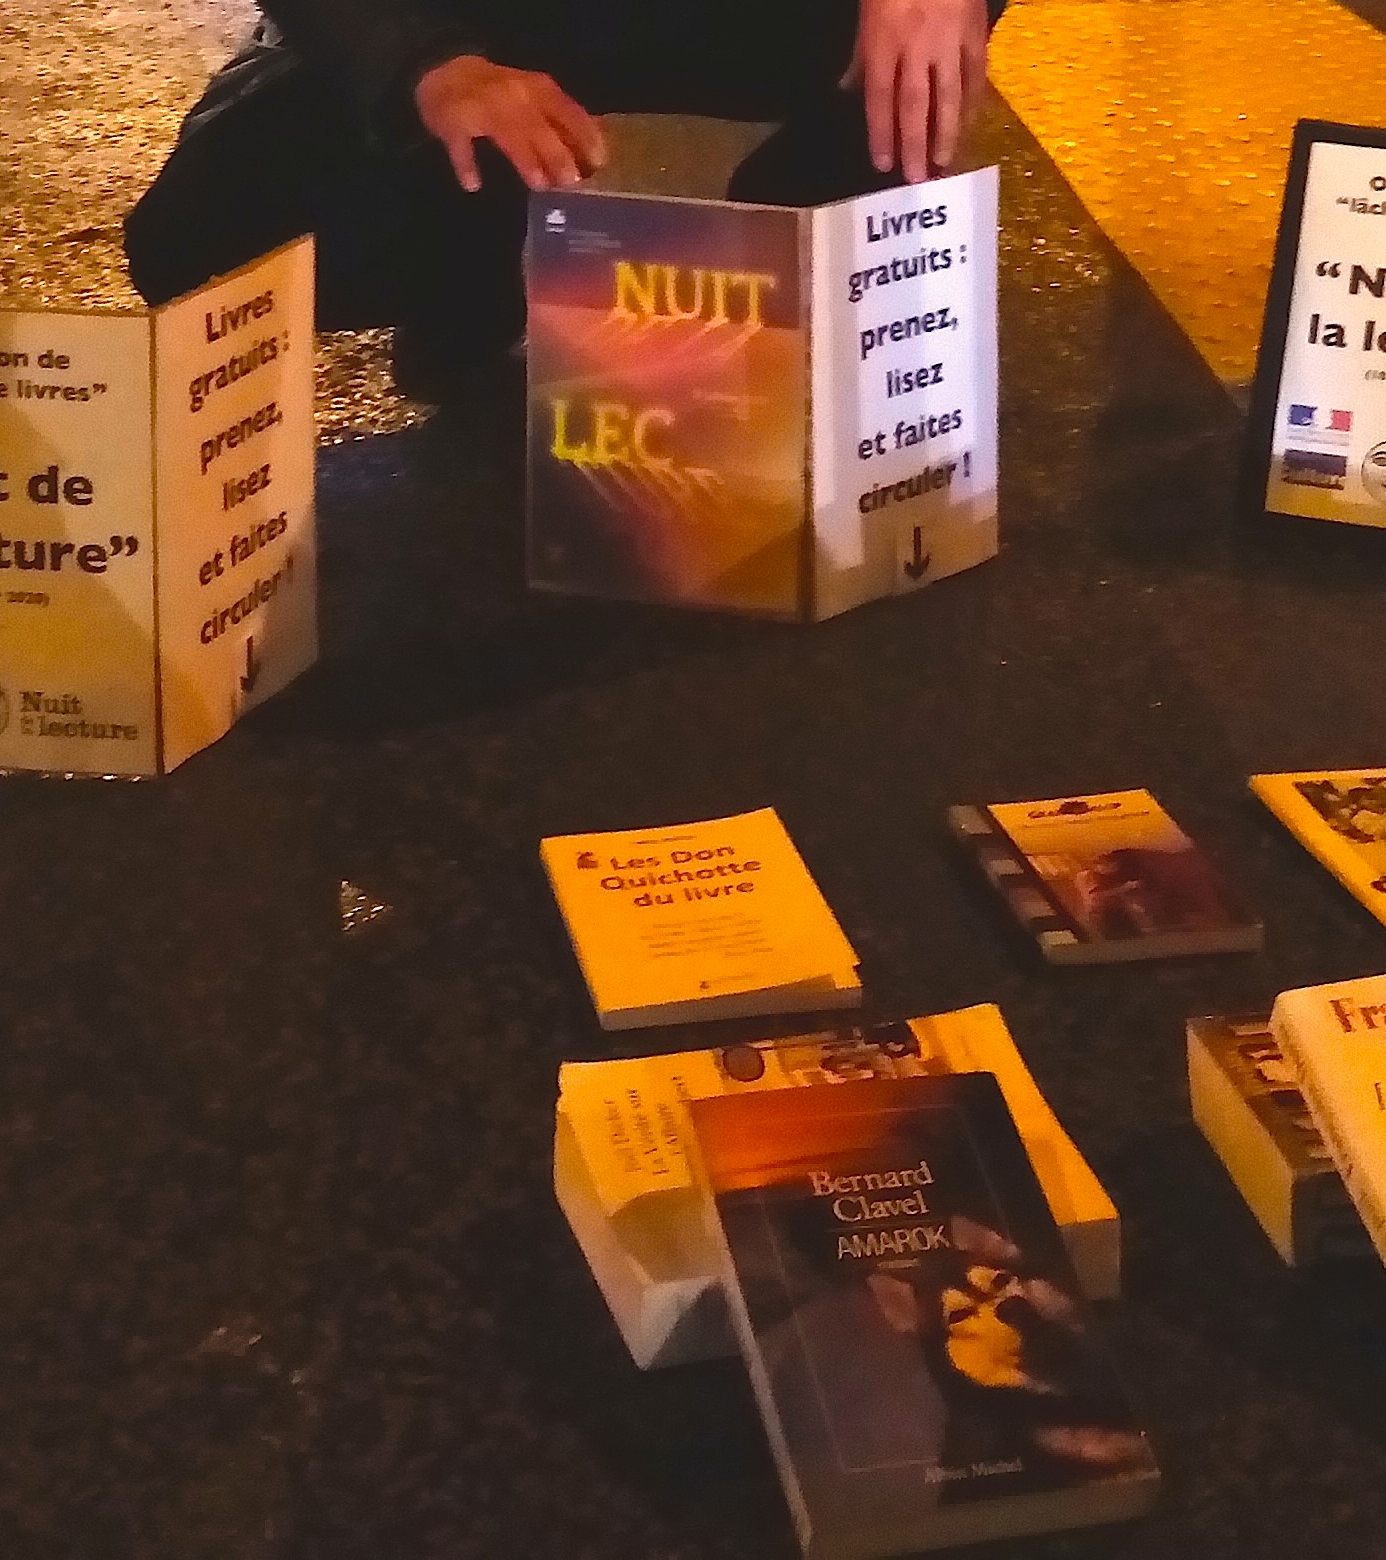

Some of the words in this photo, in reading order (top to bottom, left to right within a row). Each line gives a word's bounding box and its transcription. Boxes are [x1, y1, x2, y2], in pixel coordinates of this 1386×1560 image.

[865, 204, 948, 244] Livres
[613, 260, 777, 327] NUIT
[205, 289, 275, 345] Livres
[859, 306, 959, 361] prenez,
[1308, 313, 1347, 349] la
[37, 348, 71, 370] de
[886, 362, 944, 399] lisez
[200, 401, 284, 477] prenez,
[857, 430, 887, 461] et
[893, 408, 962, 450] faites
[27, 463, 94, 507] de
[222, 462, 272, 511] lisez
[859, 462, 958, 514] circuler
[199, 549, 225, 586] et
[230, 511, 288, 567] faites
[200, 569, 282, 645] circuler
[19, 690, 83, 716] Nuit
[39, 716, 139, 741] lecture
[599, 857, 764, 892] Quichotte
[609, 854, 661, 872] Les
[670, 842, 737, 865] Don
[632, 890, 676, 909] du
[684, 878, 757, 903] livre
[807, 1158, 937, 1198] Bernard
[831, 1188, 931, 1224] Clavel
[837, 1223, 952, 1262] AMAROK
